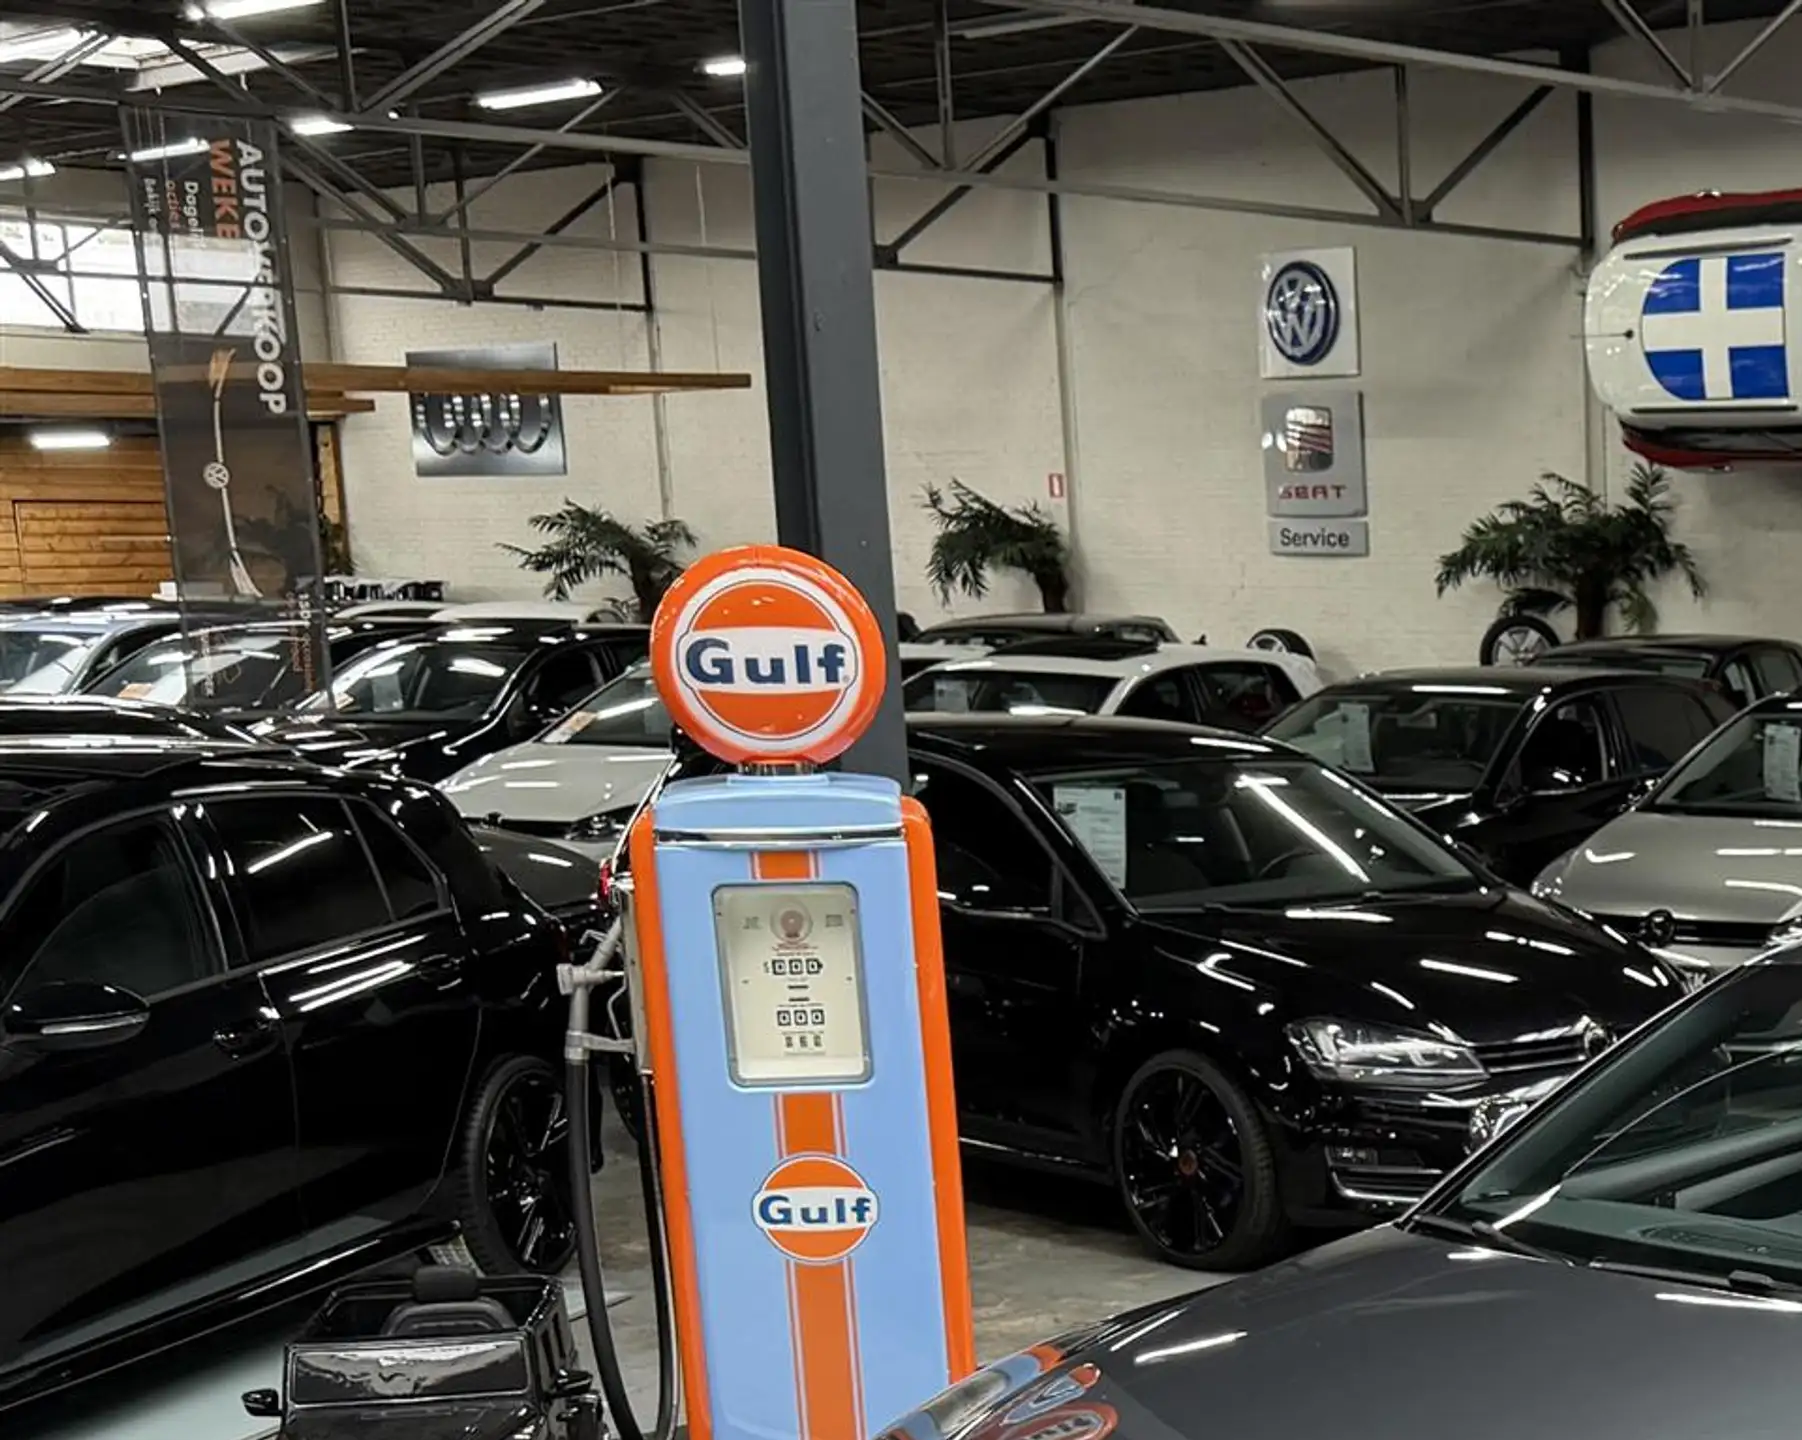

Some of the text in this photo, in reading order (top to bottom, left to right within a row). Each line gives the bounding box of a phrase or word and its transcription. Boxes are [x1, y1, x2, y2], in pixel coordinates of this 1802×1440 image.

[1280, 527, 1350, 548] Service
[685, 638, 846, 685] Gulf
[758, 1194, 872, 1226] Gulf
